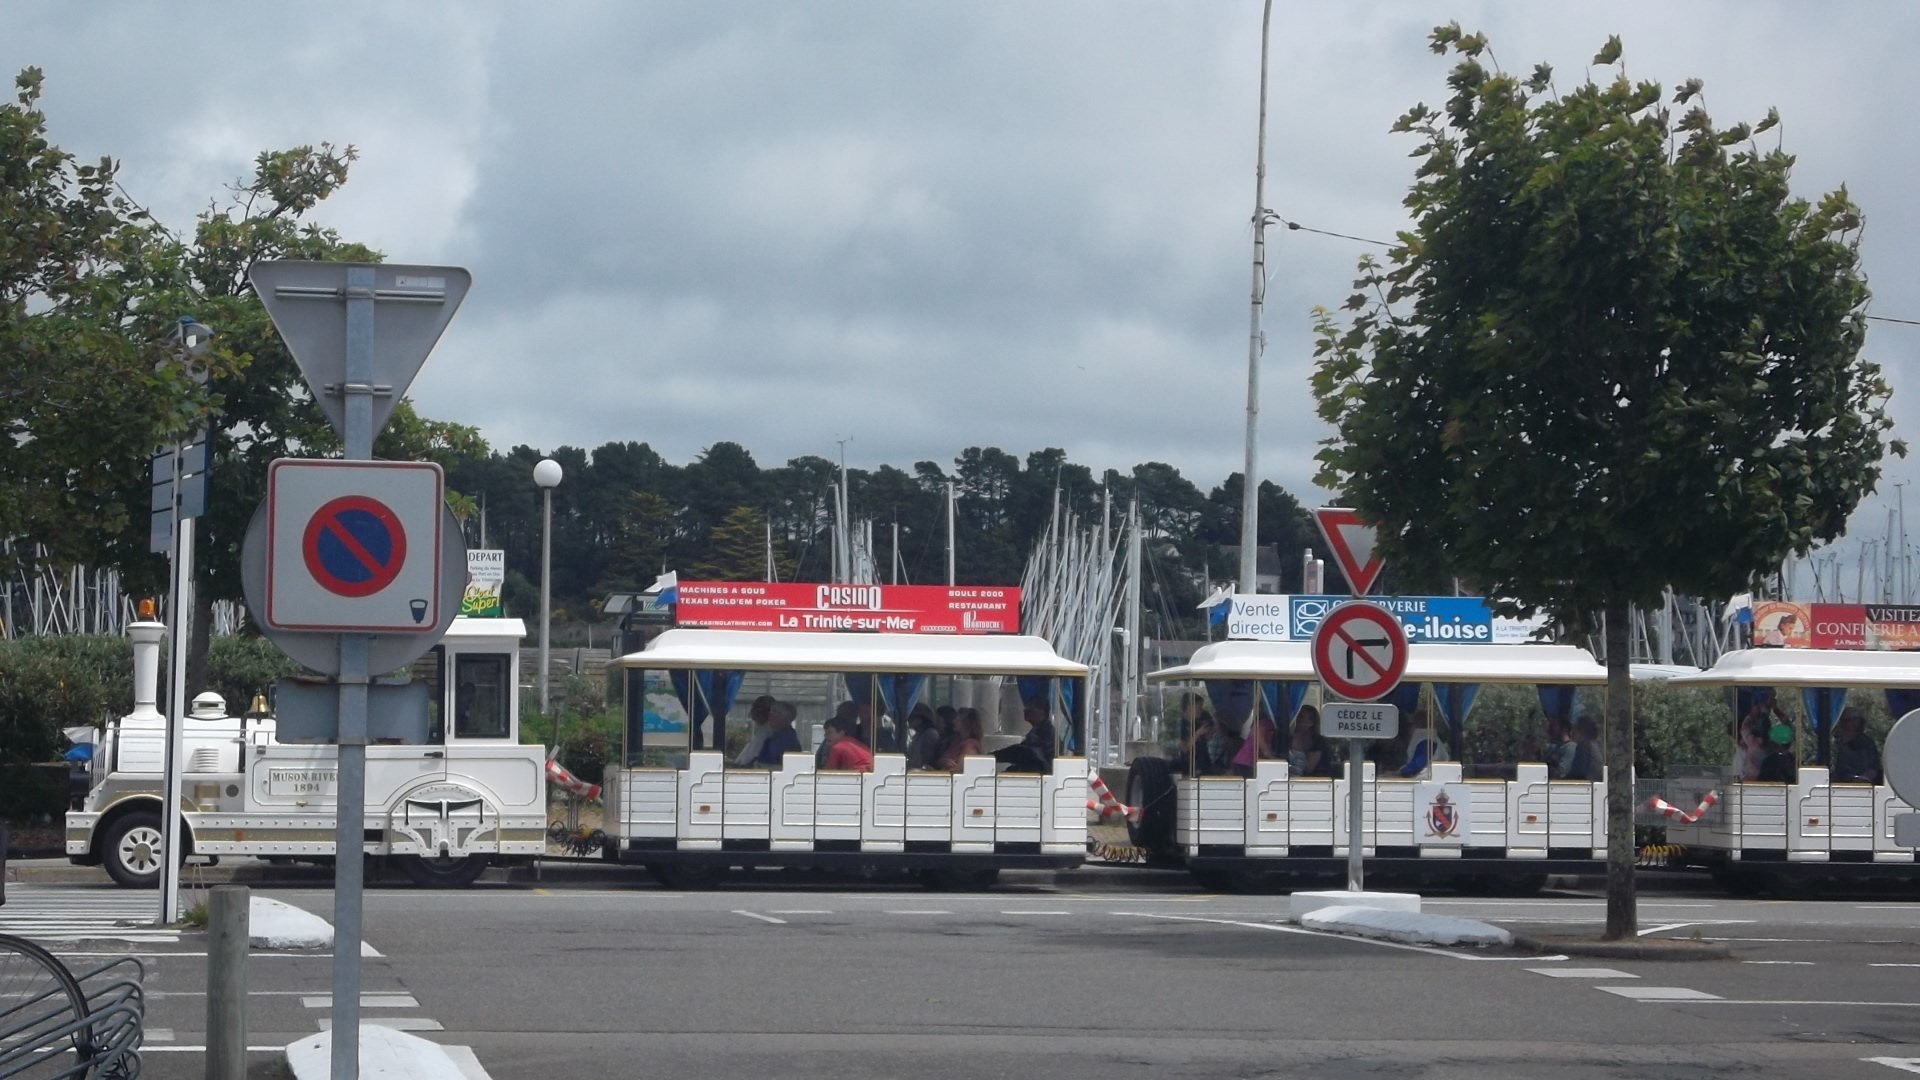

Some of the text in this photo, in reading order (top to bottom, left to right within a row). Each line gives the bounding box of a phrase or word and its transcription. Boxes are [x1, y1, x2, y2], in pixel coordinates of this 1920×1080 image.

[468, 552, 503, 562] DEPART
[680, 597, 709, 605] TEXAS
[816, 585, 882, 610] CASINO
[1234, 601, 1280, 617] Vente
[779, 614, 799, 628] La
[802, 615, 916, 630] Trinité-sur-Mer
[1230, 620, 1285, 635] directe
[1816, 622, 1905, 637] CONFISERIE
[1337, 708, 1383, 721] CÉDEZ LE
[1338, 722, 1382, 732] PASSAGE
[272, 772, 338, 782] MUSON RIVE
[294, 783, 320, 792] 1894
